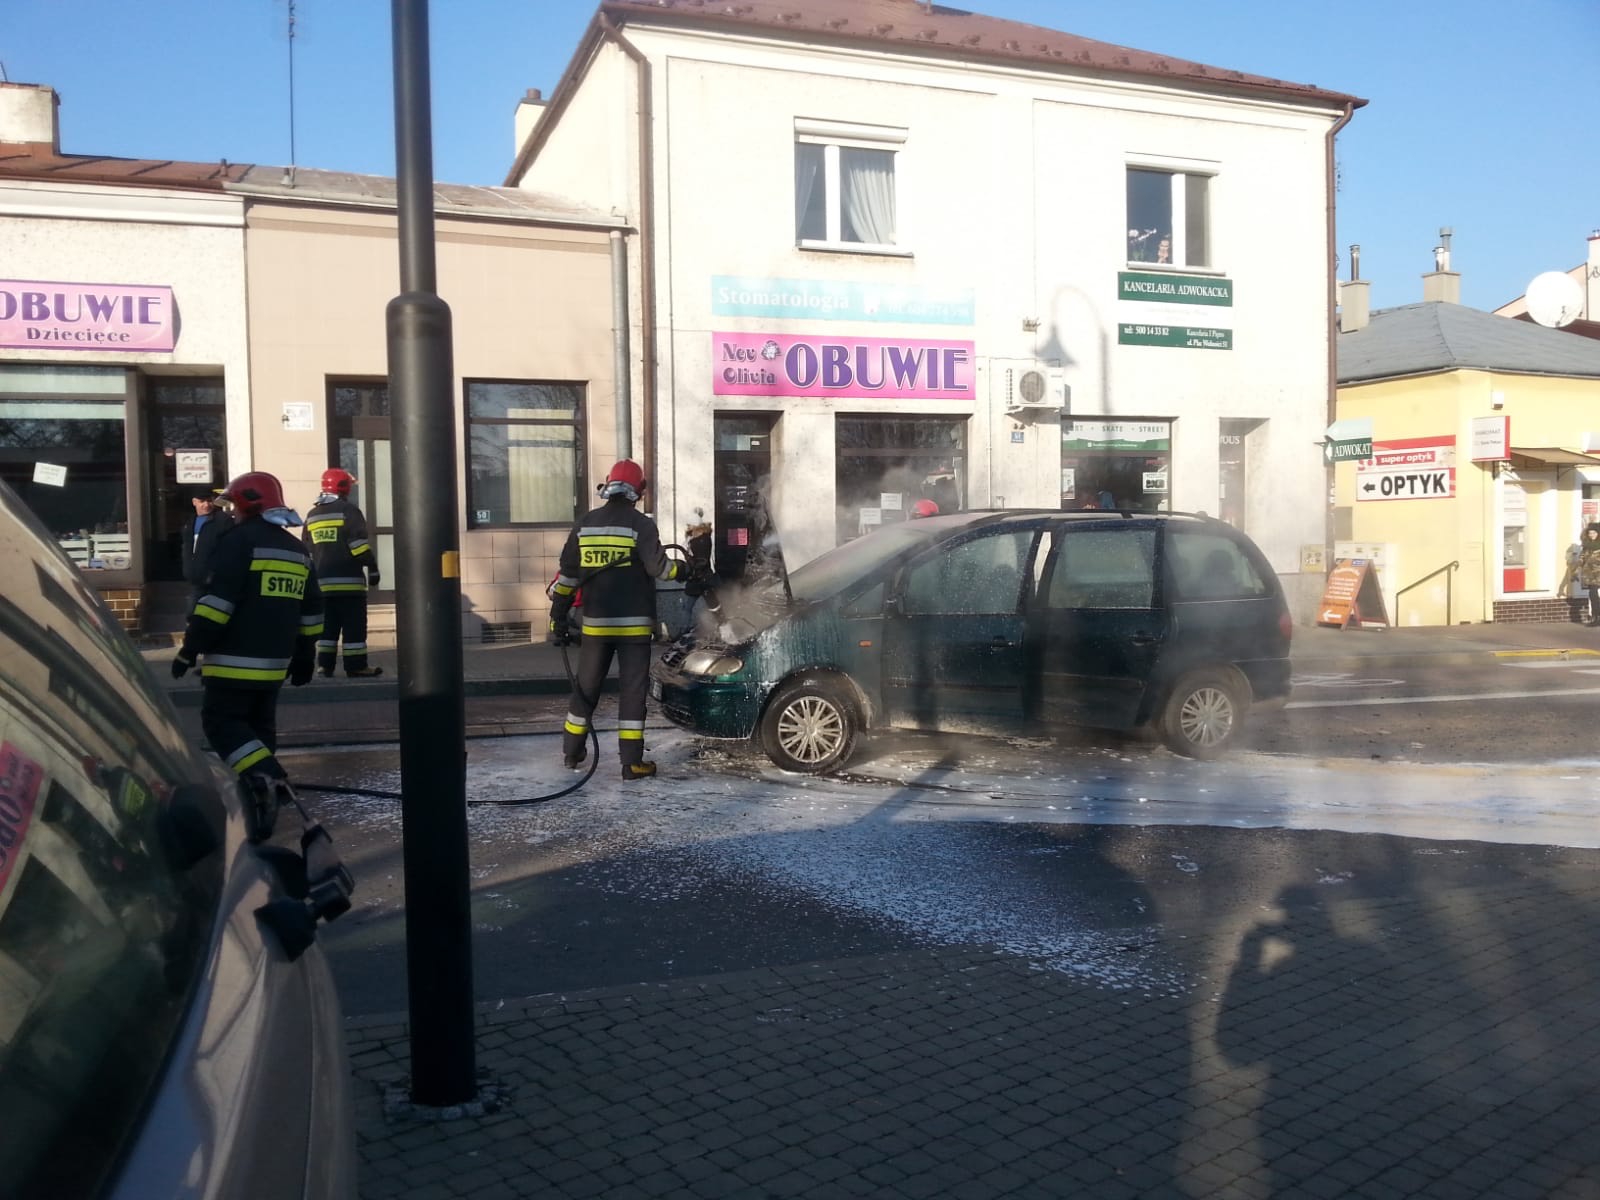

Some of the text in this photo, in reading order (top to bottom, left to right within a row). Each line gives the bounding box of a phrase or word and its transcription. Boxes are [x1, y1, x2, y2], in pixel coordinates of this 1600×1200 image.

[1124, 281, 1229, 297] KANCELARIA ADWOKACKA
[719, 286, 849, 312] Stomatologia
[26, 327, 131, 344] Dziecięce
[784, 342, 969, 391] OBUWIE
[722, 367, 777, 385] Olivia
[1334, 442, 1371, 458] ADWOKAT
[1380, 455, 1405, 464] super
[1406, 452, 1433, 463] optyk
[1380, 472, 1446, 497] OPTYK
